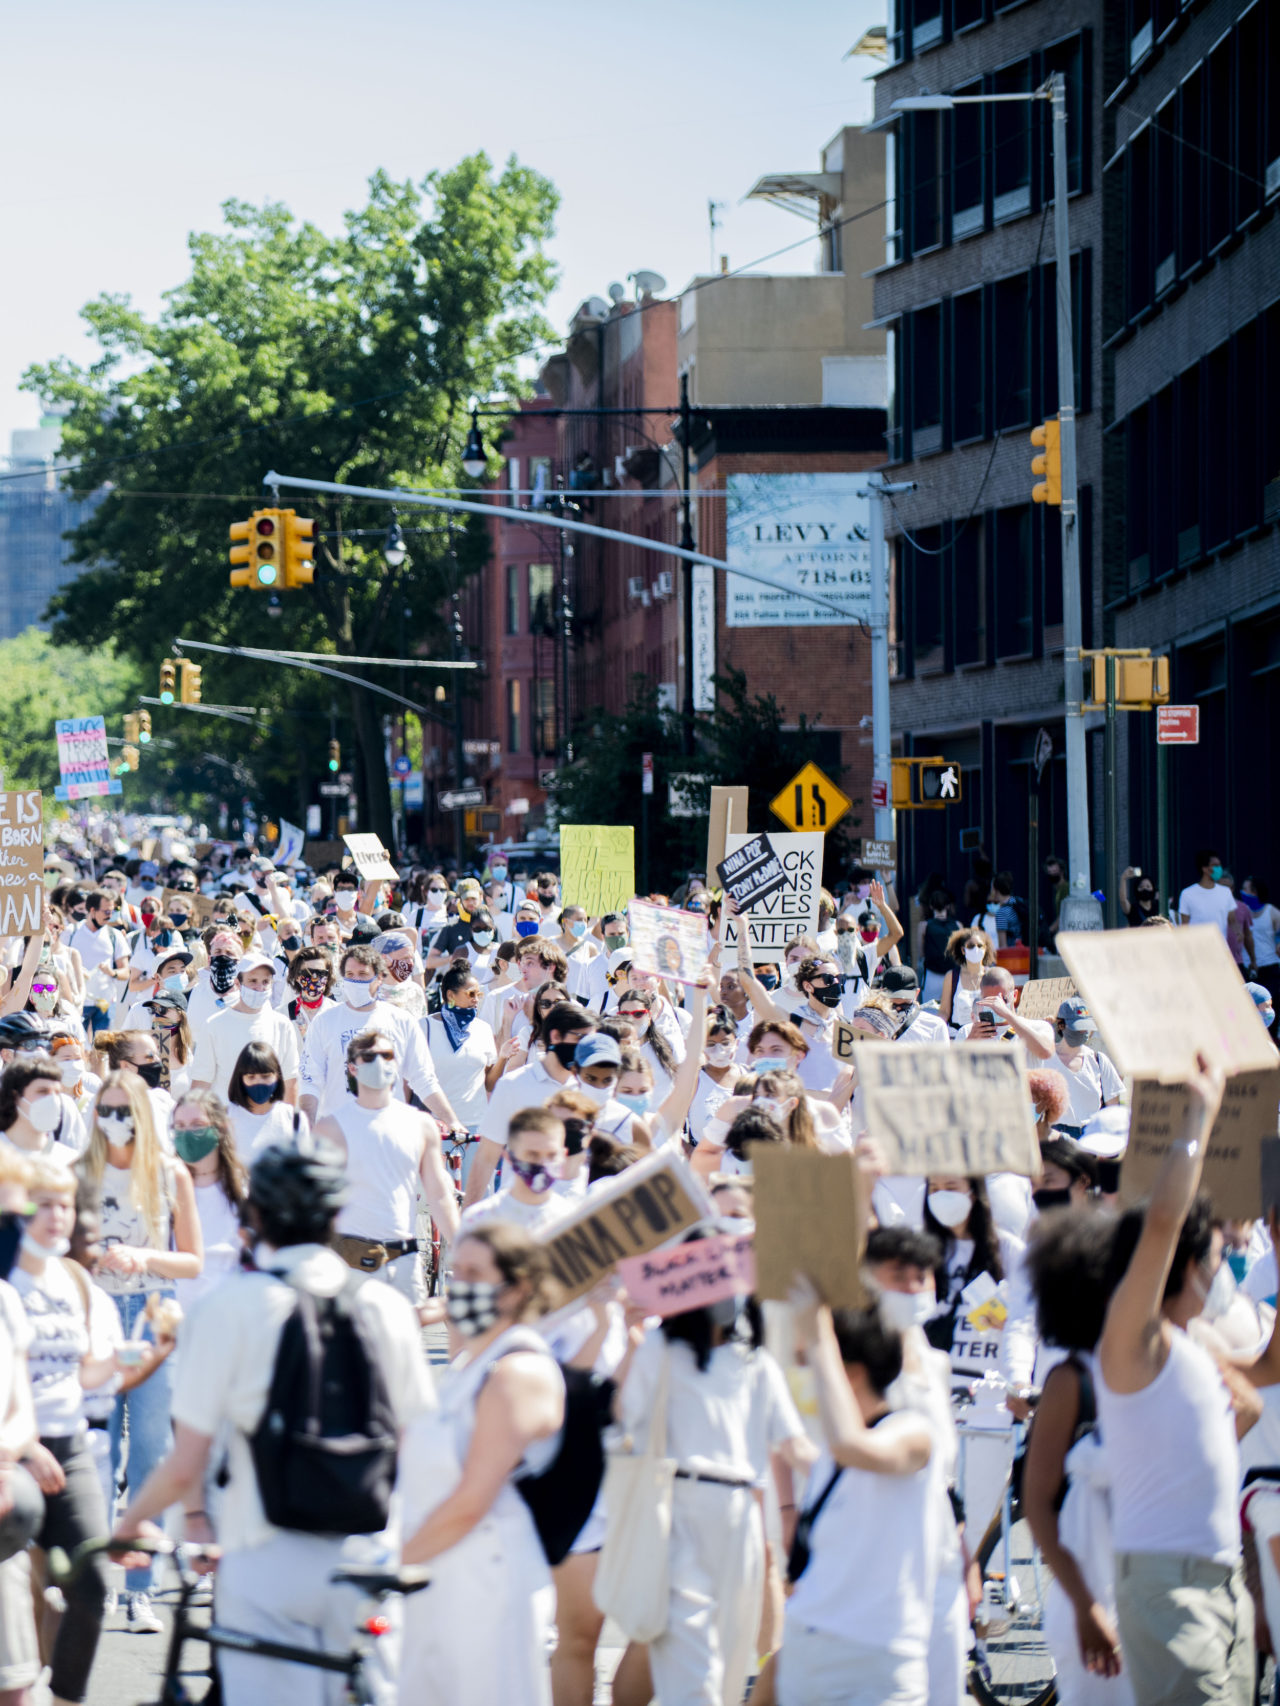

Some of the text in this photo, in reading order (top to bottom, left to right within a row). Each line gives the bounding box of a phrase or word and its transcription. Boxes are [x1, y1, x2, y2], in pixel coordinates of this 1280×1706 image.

[754, 522, 871, 543] LEVY &
[782, 551, 871, 564] ATTORNE
[16, 791, 40, 824] IS
[1, 823, 42, 847] BORN
[561, 845, 610, 871] THE
[722, 851, 748, 876] NINA
[743, 838, 762, 861] POP
[28, 871, 44, 882] a
[561, 870, 633, 896] RIGHT
[728, 875, 755, 900] TONY
[1027, 978, 1076, 993] DEFUN
